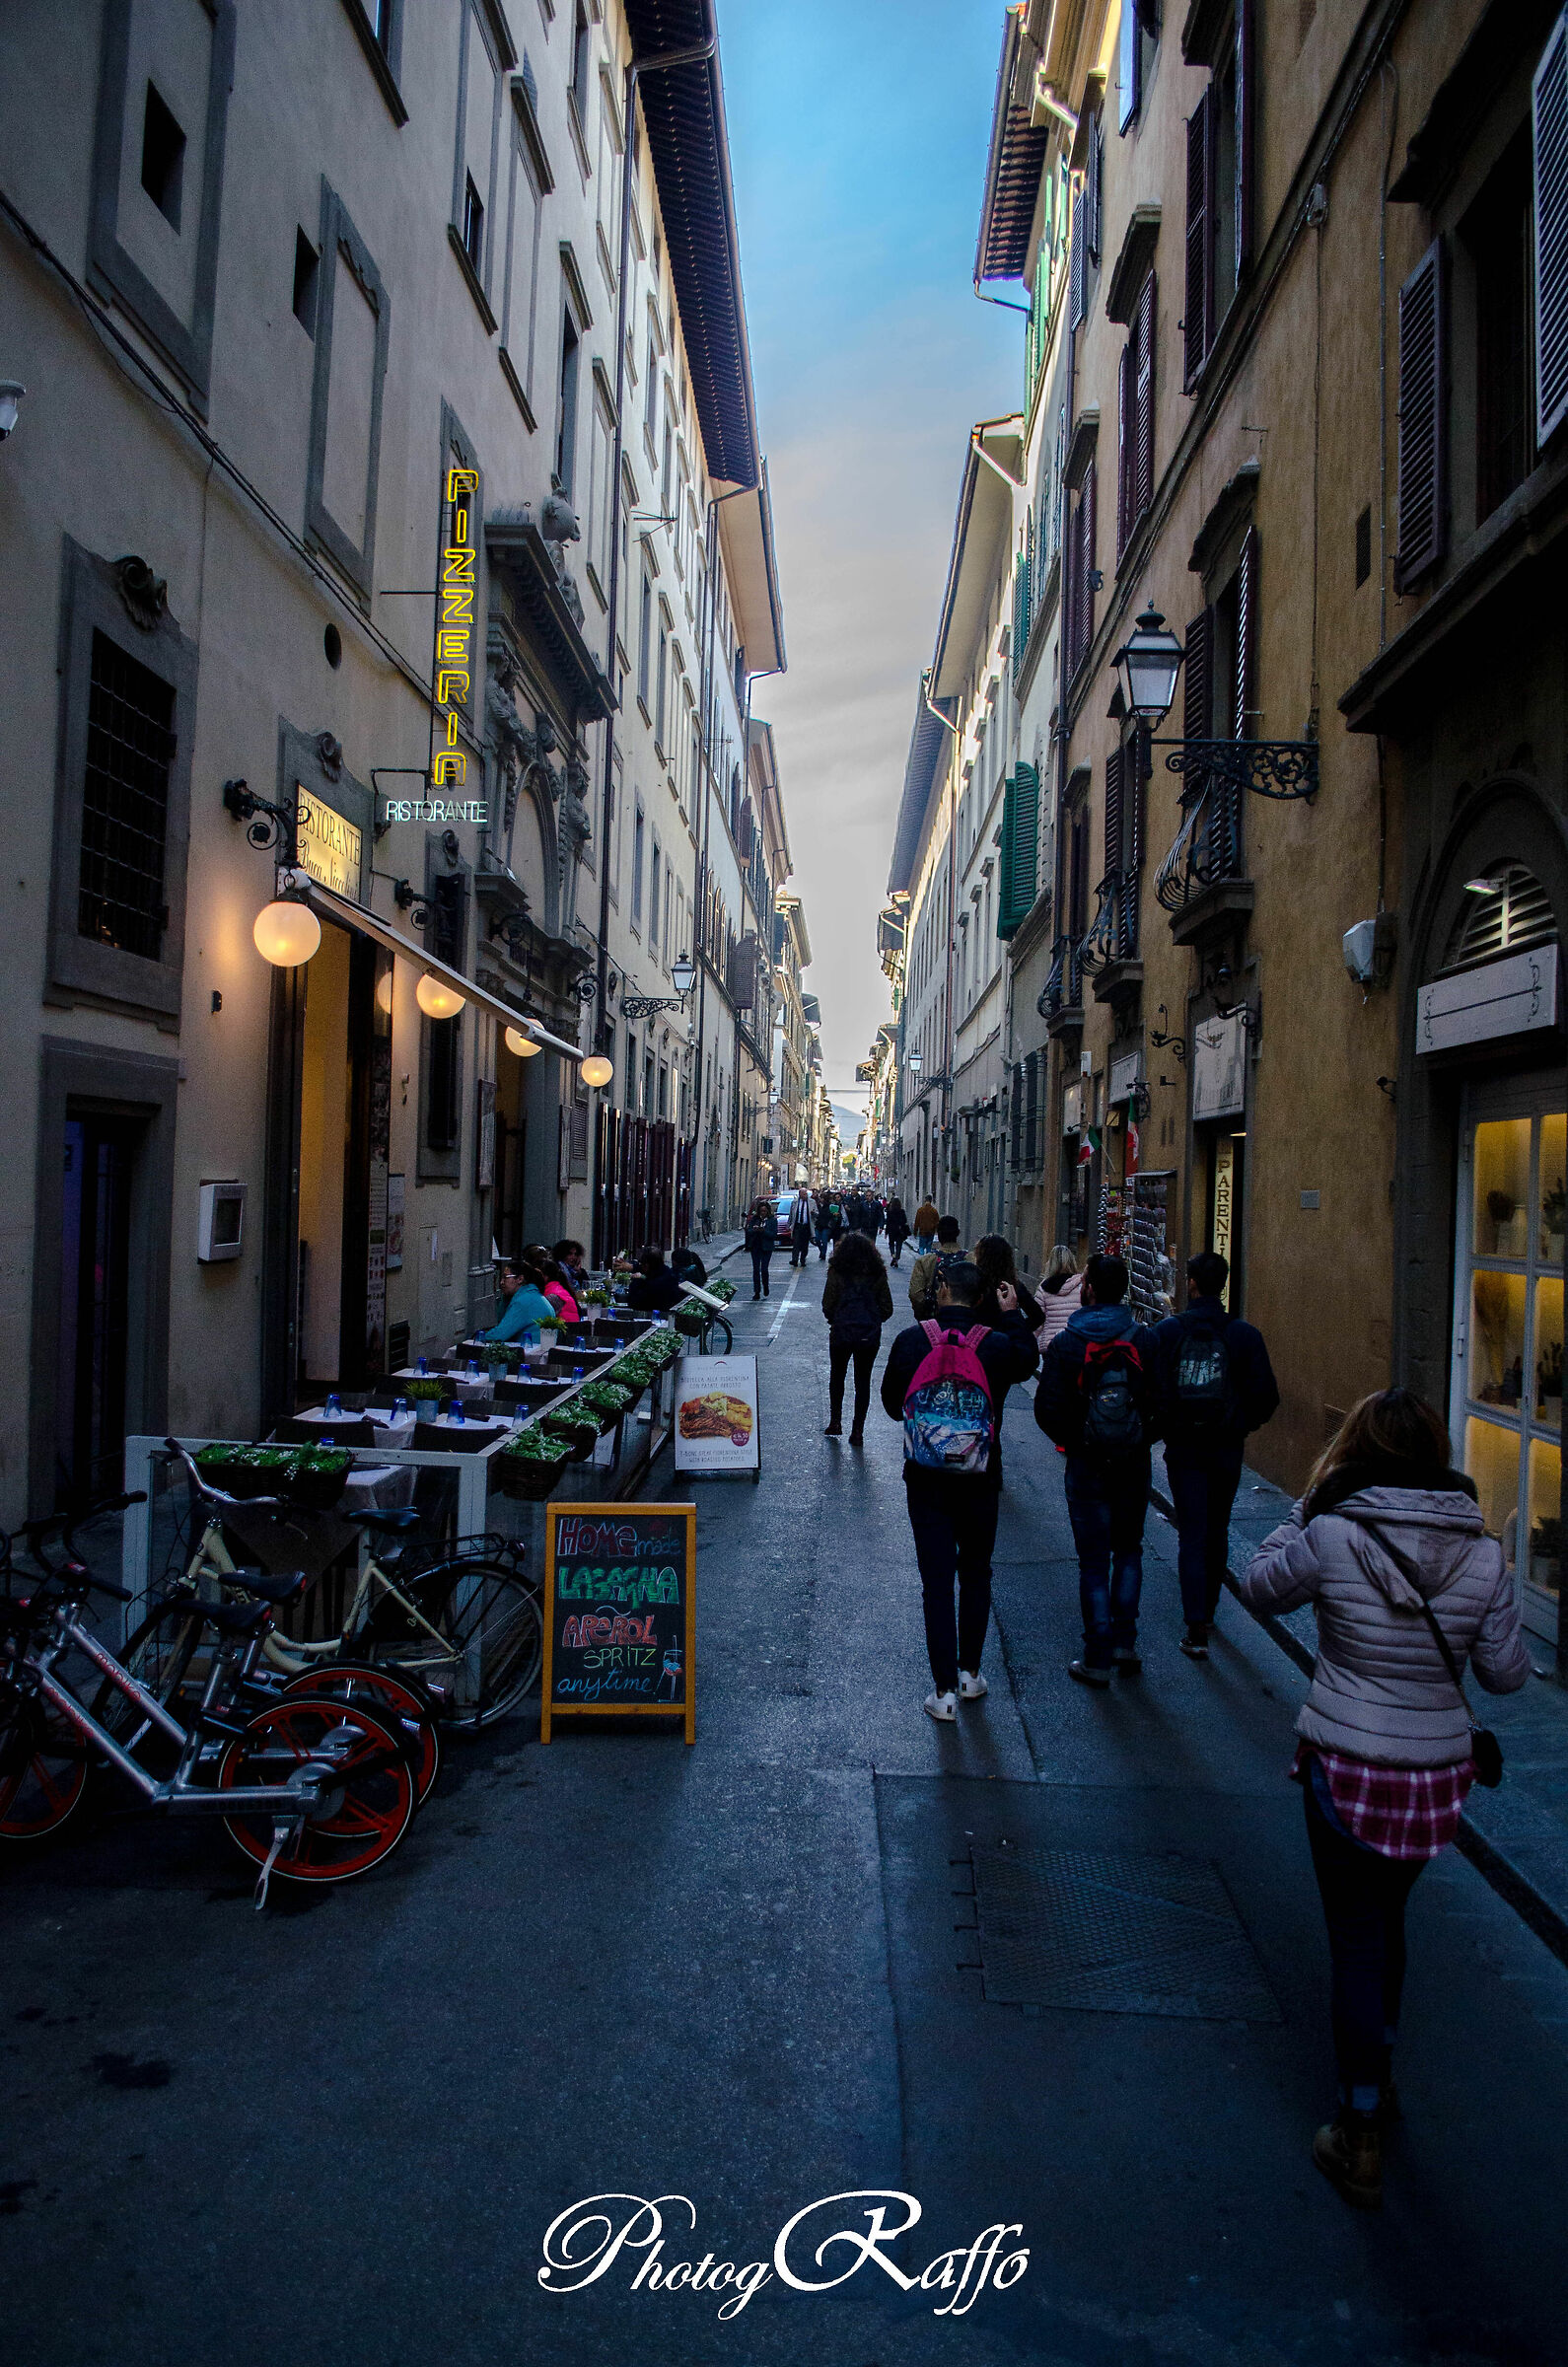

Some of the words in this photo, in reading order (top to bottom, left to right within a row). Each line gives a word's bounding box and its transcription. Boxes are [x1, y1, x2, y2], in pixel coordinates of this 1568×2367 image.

[434, 468, 479, 786] PIZZERIA
[300, 792, 361, 867] RISTORANTE
[387, 799, 489, 824] RISTORANTE
[558, 1565, 679, 1610] LASAGNA
